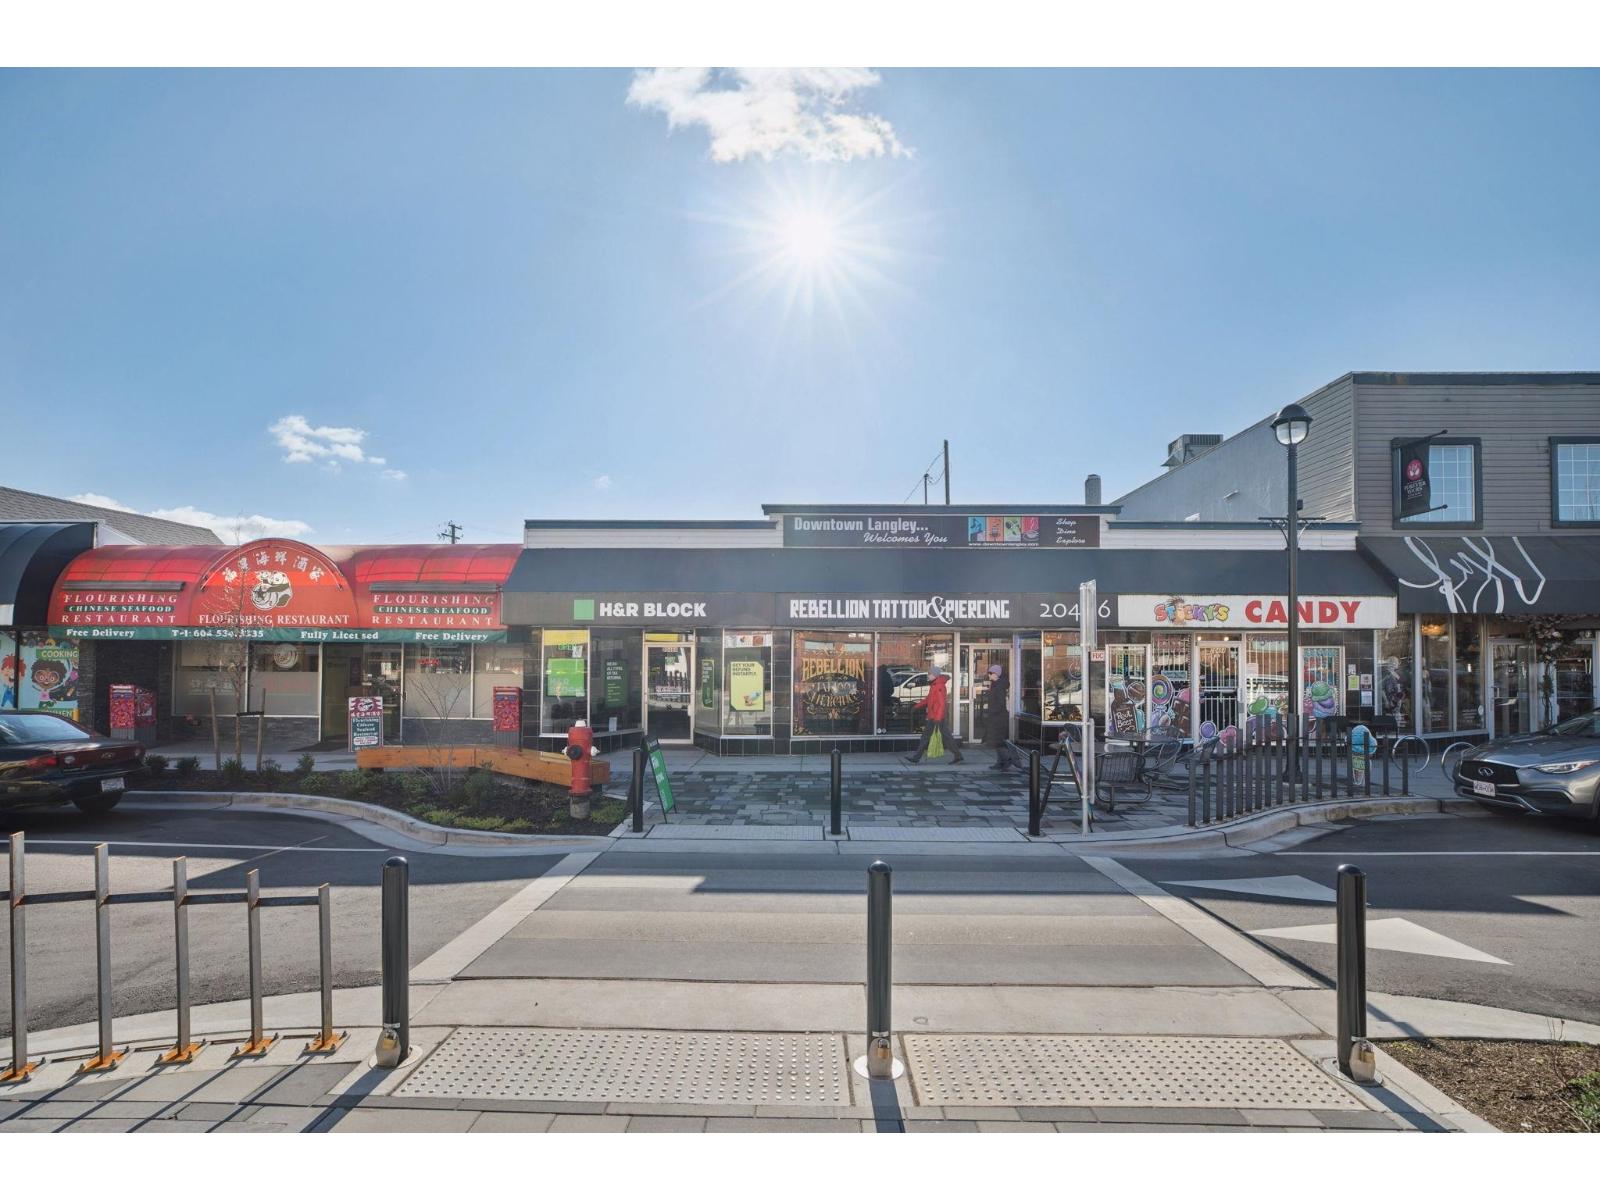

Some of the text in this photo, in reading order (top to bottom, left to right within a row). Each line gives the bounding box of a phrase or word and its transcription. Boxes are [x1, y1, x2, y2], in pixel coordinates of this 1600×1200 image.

[794, 517, 929, 533] Downtown Langley...
[1056, 518, 1077, 527] Shop
[863, 532, 949, 545] Welcomes You
[64, 594, 178, 603] FLOURISHING
[373, 594, 494, 605] FLOURISHING
[378, 606, 488, 614] CHINESE SEAFOOD
[599, 602, 706, 617] H&R BLOCK
[790, 599, 868, 618] REBELLION
[1039, 600, 1111, 622] 2046
[1244, 600, 1361, 624] CANDY
[62, 614, 176, 623] RESTAURANT
[277, 614, 350, 625] RESTAURANT
[372, 616, 494, 625] RESTAURANT
[66, 628, 135, 638] Free Delivery
[301, 631, 329, 640] Fully
[415, 632, 488, 641] Free Delivery
[41, 650, 79, 658] COOKING
[802, 658, 866, 682] REBELLION
